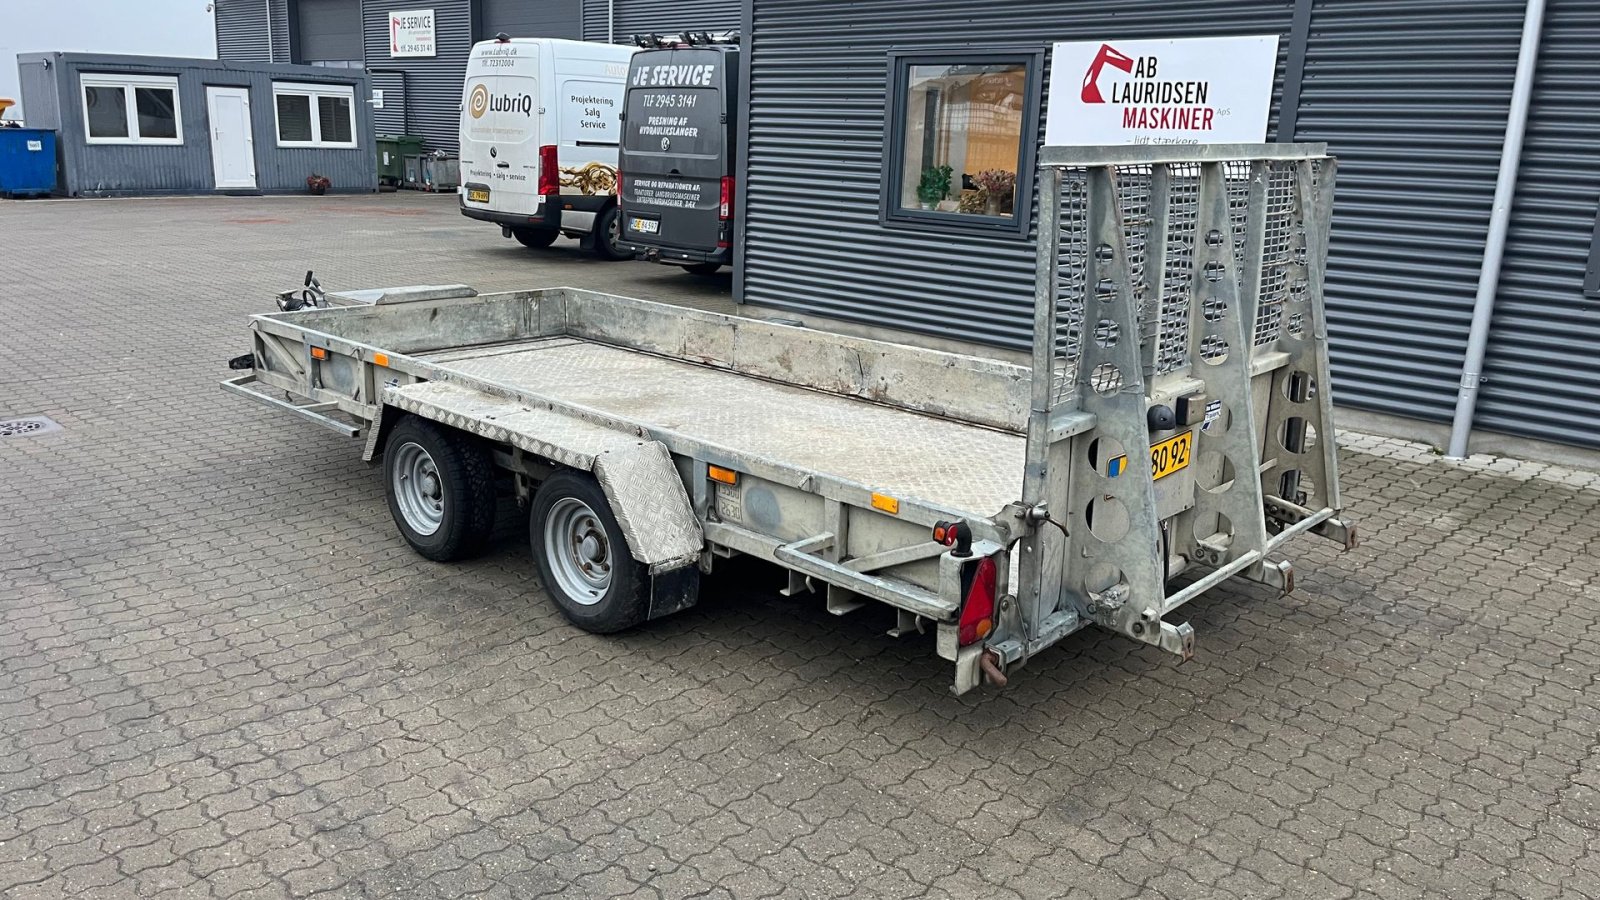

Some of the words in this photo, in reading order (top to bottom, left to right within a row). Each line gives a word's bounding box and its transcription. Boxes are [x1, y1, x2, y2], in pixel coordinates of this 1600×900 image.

[400, 18, 407, 29] JE
[408, 16, 431, 29] SERVICE
[1135, 56, 1157, 78] AB
[633, 66, 650, 86] JE
[651, 64, 715, 87] SERVICE
[1112, 81, 1209, 104] LAURIDSEN
[490, 93, 532, 117] LubriQ
[571, 95, 614, 107] Projektering
[643, 94, 654, 107] TLF
[655, 94, 675, 107] 2945
[677, 94, 697, 108] 3141
[584, 108, 600, 118] Salg
[1122, 107, 1214, 130] MASKINER
[1216, 108, 1231, 117] ApS
[580, 120, 606, 129] Service
[648, 116, 678, 126] PRESNING
[678, 117, 688, 126] AF
[639, 126, 698, 137] HYDRAULIKSLANGER
[634, 179, 651, 188] SERVICE
[1152, 446, 1168, 476] 80
[1171, 438, 1187, 468] 92
